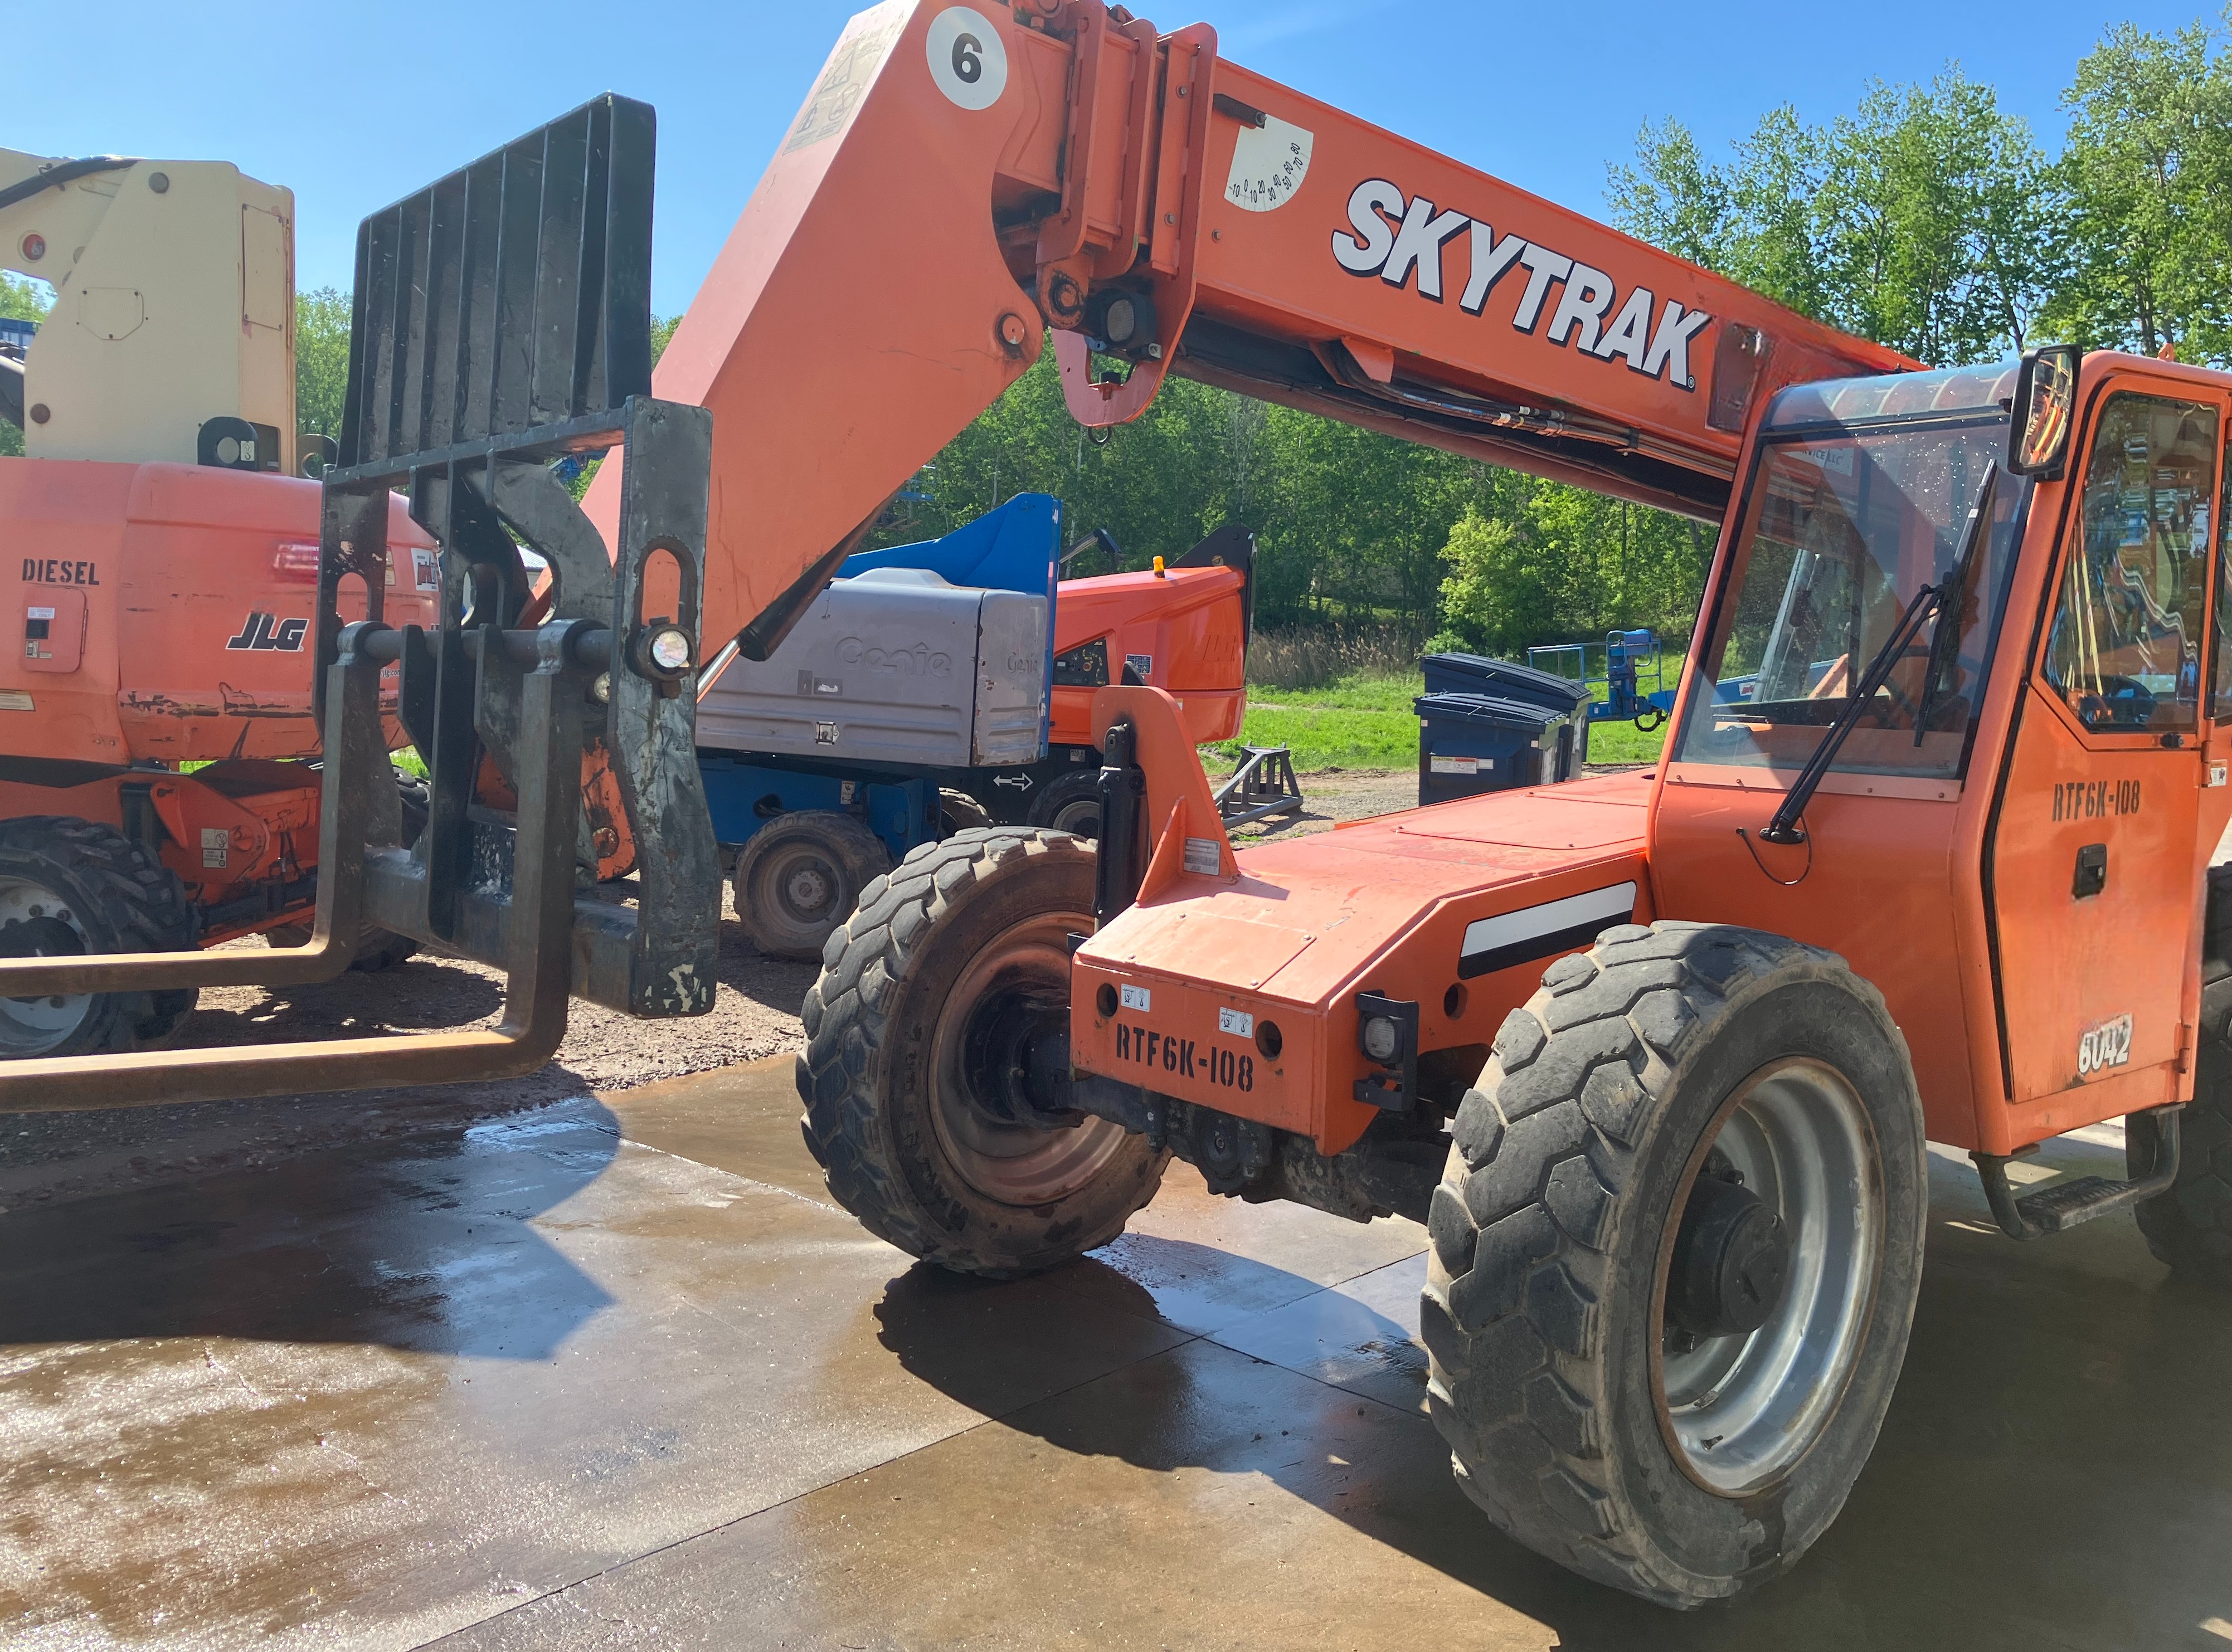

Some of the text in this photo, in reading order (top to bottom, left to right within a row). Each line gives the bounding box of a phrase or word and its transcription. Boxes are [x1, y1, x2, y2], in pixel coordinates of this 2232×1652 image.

[952, 33, 983, 84] 6
[1290, 142, 1300, 155] 80
[1283, 160, 1294, 175] 60
[1293, 157, 1303, 170] 70
[1244, 179, 1248, 192] 0
[1257, 180, 1265, 194] 20
[1272, 174, 1281, 188] 40
[1282, 176, 1292, 190] 50
[1250, 189, 1257, 203] 10
[1267, 187, 1276, 201] 30
[1331, 177, 1713, 391] SKYTRAK
[22, 558, 99, 585] DIESEL
[225, 612, 310, 651] JLG
[2051, 779, 2141, 822] RTF6K-108
[2078, 1013, 2133, 1074] 6042
[1116, 1023, 1253, 1093] RTF6K-108
